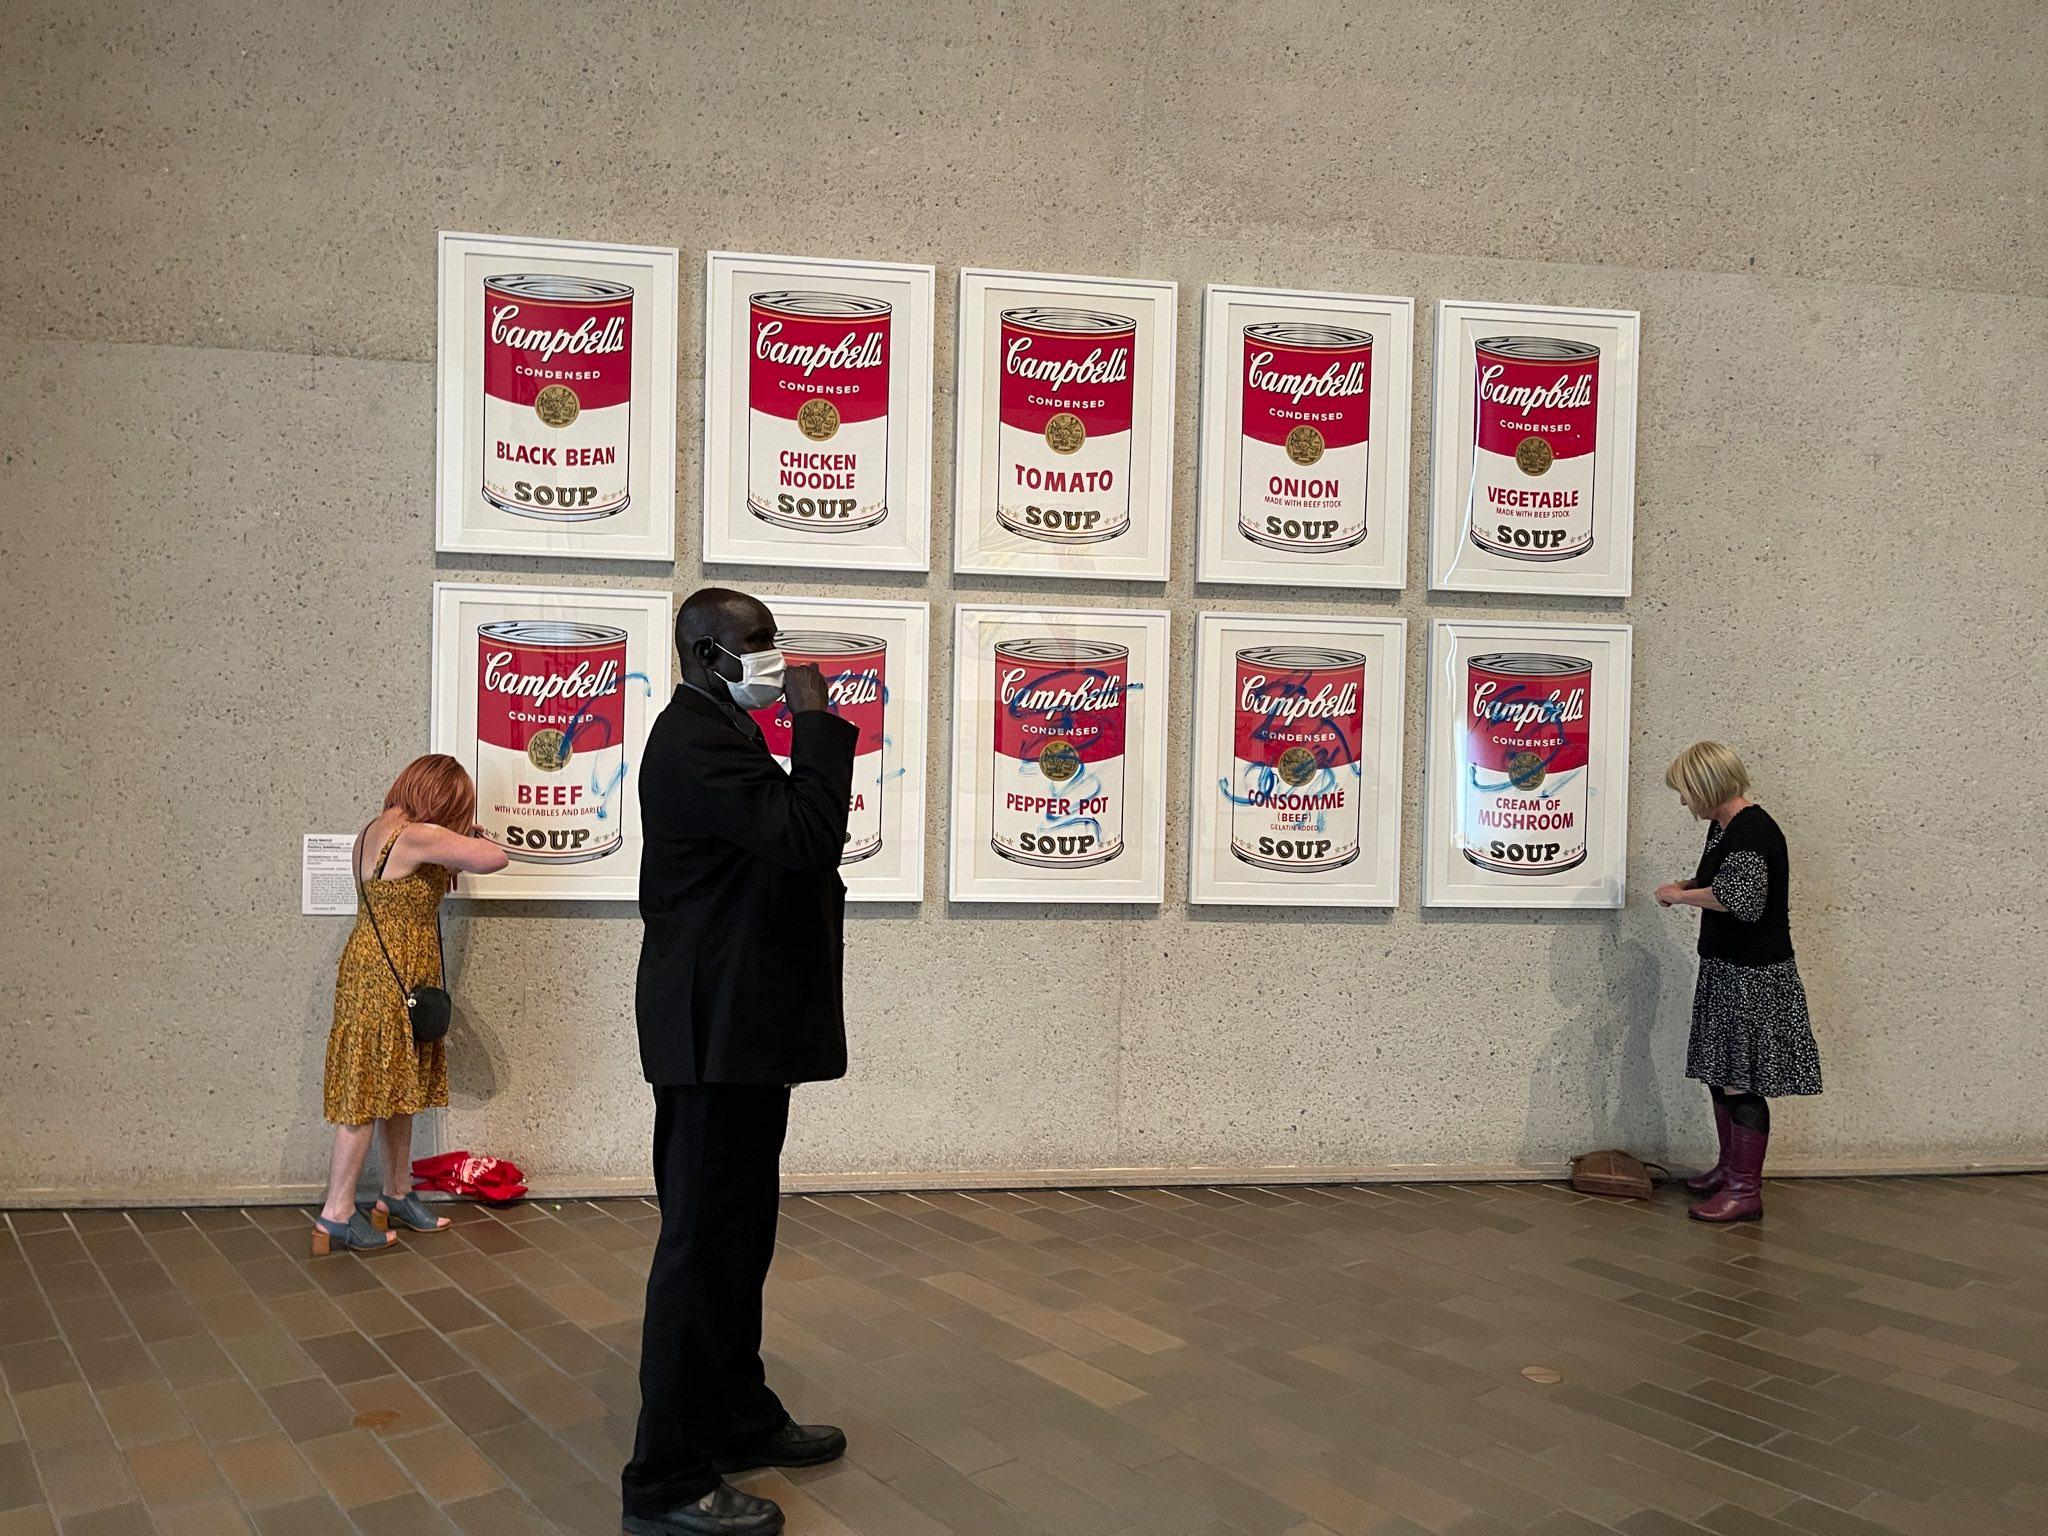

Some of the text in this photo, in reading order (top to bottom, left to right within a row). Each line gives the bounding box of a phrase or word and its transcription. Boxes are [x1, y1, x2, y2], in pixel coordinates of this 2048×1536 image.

[491, 304, 625, 362] Campbell's
[756, 321, 884, 377] Campbell's
[515, 365, 601, 380] CONDENSED
[1006, 337, 1128, 392] Campbell's
[778, 380, 860, 395] CONDENSED
[1248, 351, 1365, 405] Campbell's
[1480, 364, 1593, 416] Campbell's
[1027, 395, 1105, 409] CONDENSED
[1269, 408, 1343, 421] CONDENSED
[1500, 419, 1571, 433] CONDENSED
[497, 440, 615, 467] BLACK BEAN
[779, 450, 857, 470] CHICKEN
[779, 470, 855, 490] NOODLE
[1015, 463, 1113, 493] TOMATO
[1269, 476, 1339, 498] ONION
[514, 481, 597, 507] SOUP
[777, 493, 857, 519] SOUP
[1264, 496, 1342, 509] MADE WITH BEEF STOCK
[1487, 485, 1579, 509] VEGETABLE
[1025, 505, 1101, 531] SOUP
[1496, 507, 1570, 519] MADE WITH BEEF STOCK
[1266, 515, 1339, 540] SOUP
[1497, 524, 1567, 548] SOUP
[484, 651, 618, 708] Campbell's
[1001, 668, 1120, 720] Campbell's
[1241, 675, 1357, 727] Campbell's
[508, 711, 594, 724] CONDENSED
[1473, 681, 1584, 732] Campbell's
[1022, 724, 1099, 737] CONDENSED
[1261, 730, 1336, 742] CONDENSED
[1492, 735, 1564, 747] CONDENSED
[517, 784, 583, 806] BEEF
[1006, 792, 1109, 816] PEPPER POT
[1248, 787, 1345, 811] CONSOMMÉ
[1496, 797, 1561, 811] CREAM OF
[494, 804, 510, 814] WITH
[511, 806, 560, 817] VEGETABLES
[562, 807, 579, 817] AND
[1277, 812, 1312, 823] (BEEF)
[1477, 809, 1574, 831] MUSHROOM
[506, 825, 590, 850] SOUP
[1270, 823, 1320, 832] GELATIN ADDED
[1019, 832, 1095, 856] SOUP
[1258, 836, 1332, 860] SOUP
[1490, 840, 1561, 862] SOUP
